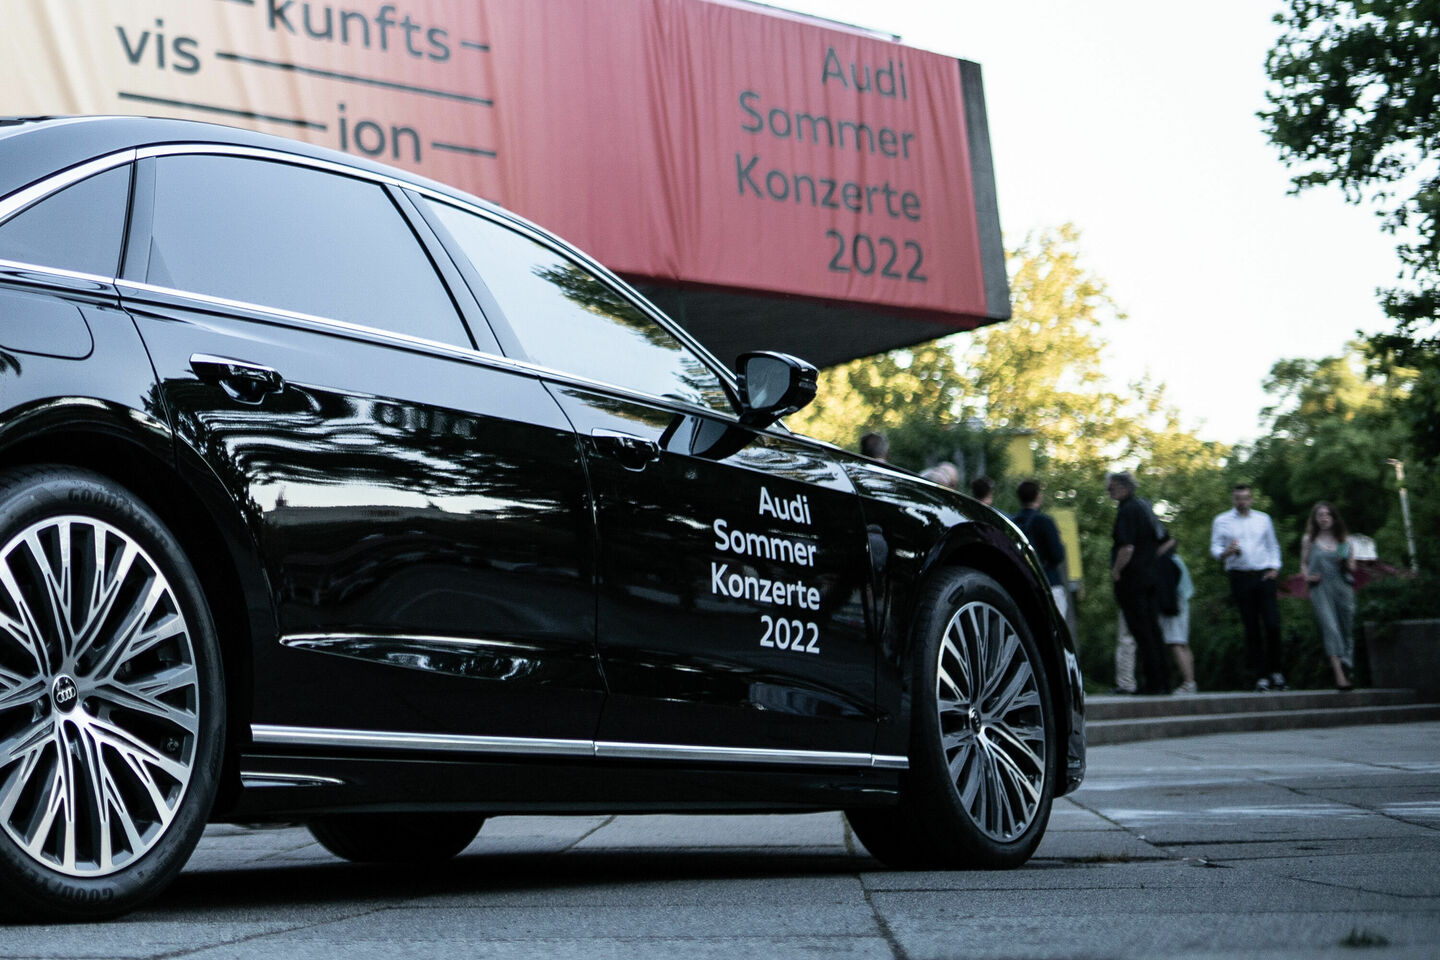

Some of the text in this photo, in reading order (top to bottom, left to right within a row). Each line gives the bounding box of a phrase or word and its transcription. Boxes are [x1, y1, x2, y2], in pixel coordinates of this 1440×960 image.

[821, 47, 908, 100] Audi
[738, 91, 914, 160] Sommer
[735, 152, 922, 222] Konzerte
[825, 230, 928, 282] 2022
[758, 486, 812, 525] Audi
[712, 518, 817, 567] Sommer
[711, 561, 820, 611] Konzerte
[759, 614, 820, 654] 2022
